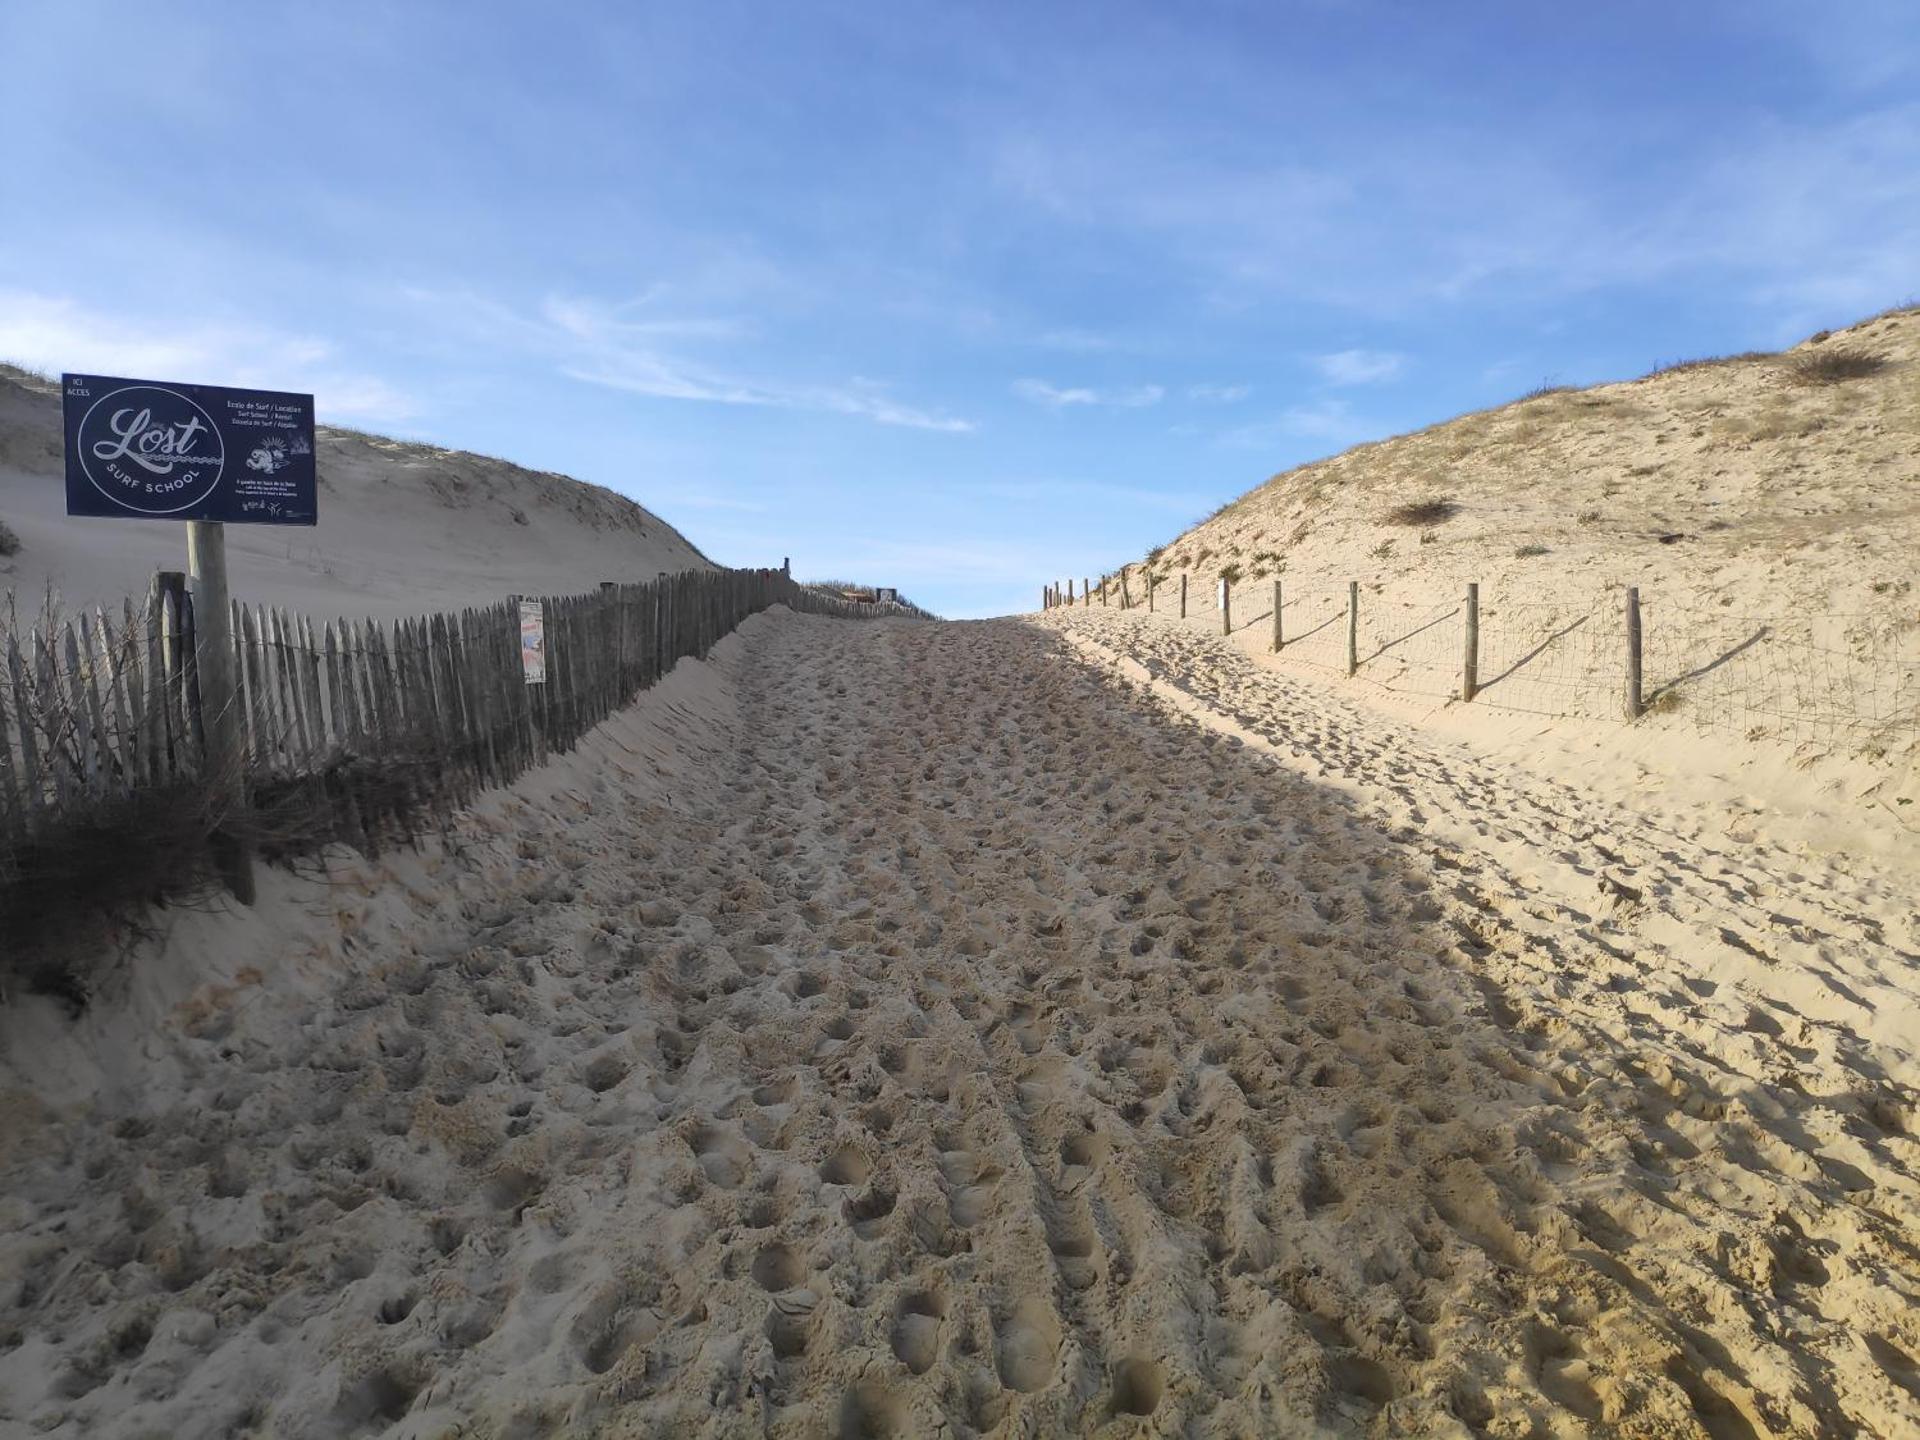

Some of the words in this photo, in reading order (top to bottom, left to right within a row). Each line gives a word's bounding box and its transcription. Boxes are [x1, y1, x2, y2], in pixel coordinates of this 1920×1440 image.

[72, 378, 83, 386] ICI
[93, 408, 208, 474] Lost
[106, 463, 140, 489] SURF
[145, 470, 200, 493] SCHOOL
